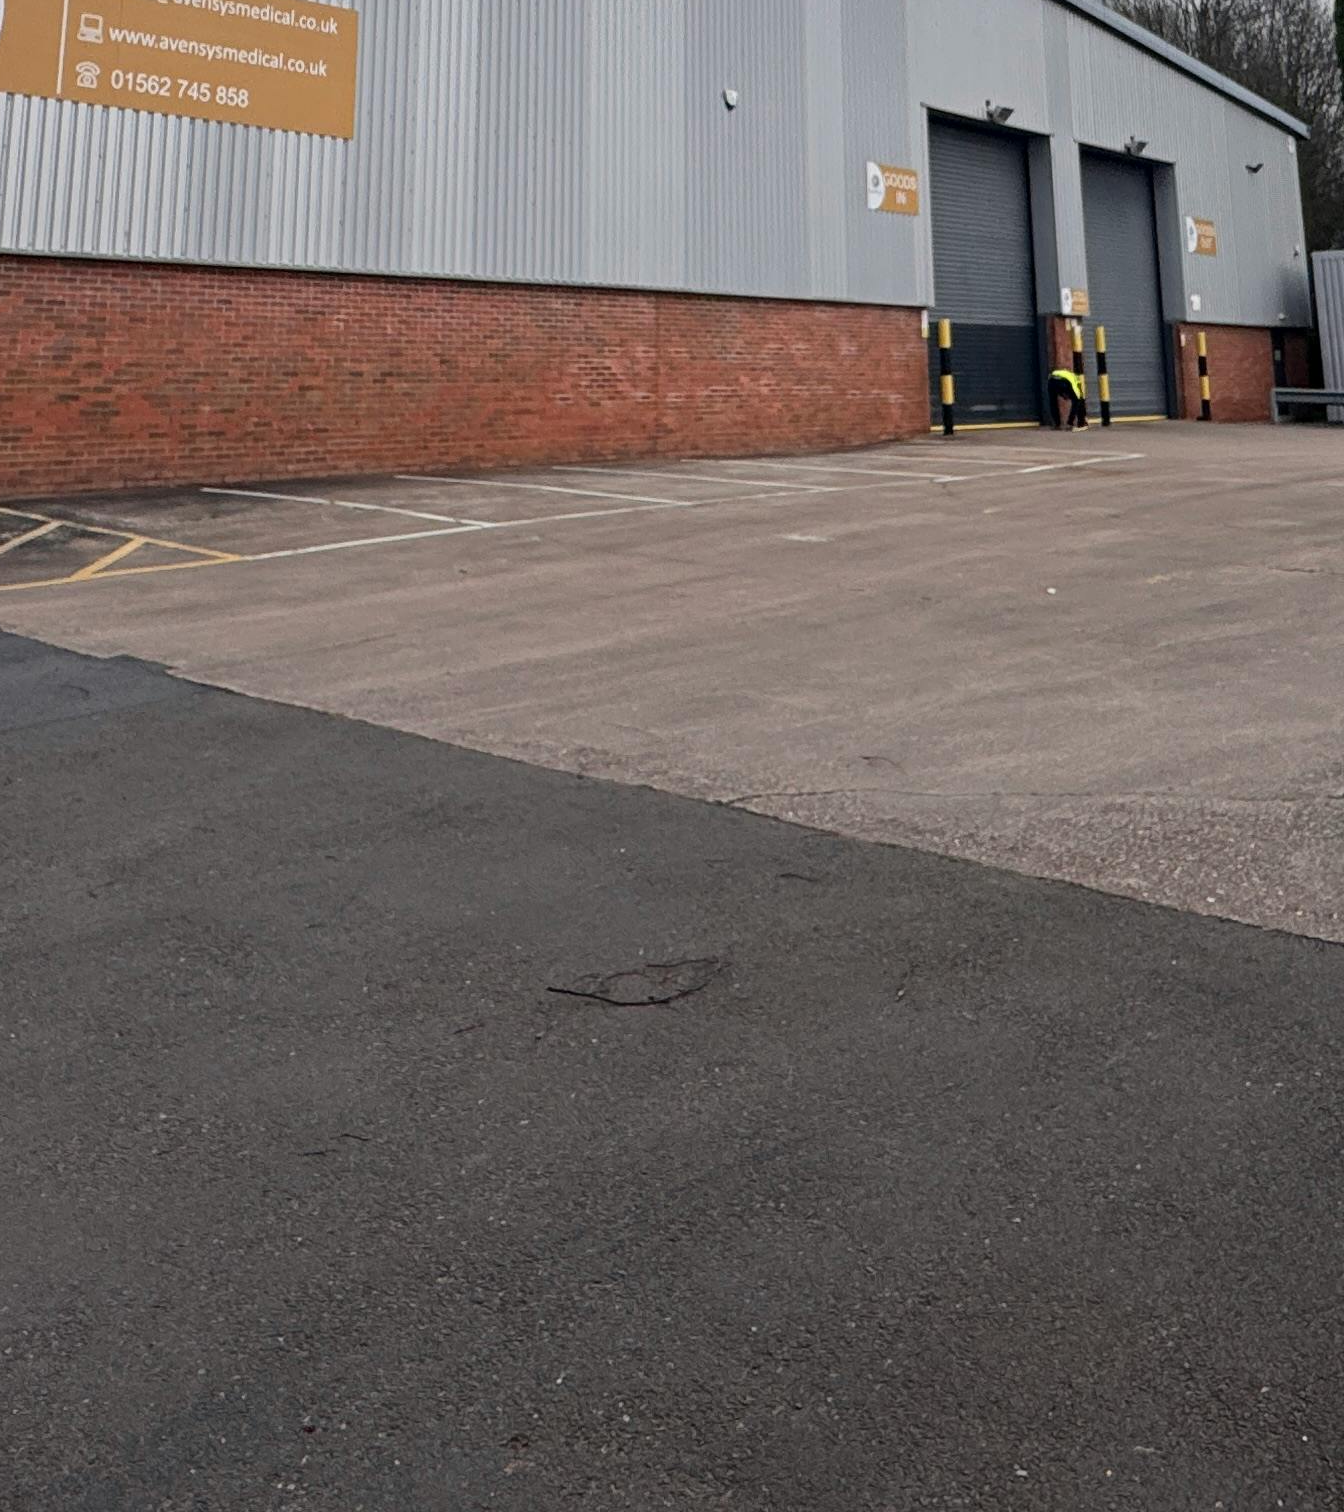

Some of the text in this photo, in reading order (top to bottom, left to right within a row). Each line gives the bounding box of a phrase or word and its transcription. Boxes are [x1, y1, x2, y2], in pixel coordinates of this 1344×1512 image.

[109, 26, 328, 77] www.avensysmedical.co.uk
[110, 69, 249, 109] 01562 745 858
[883, 171, 917, 190] GOODS
